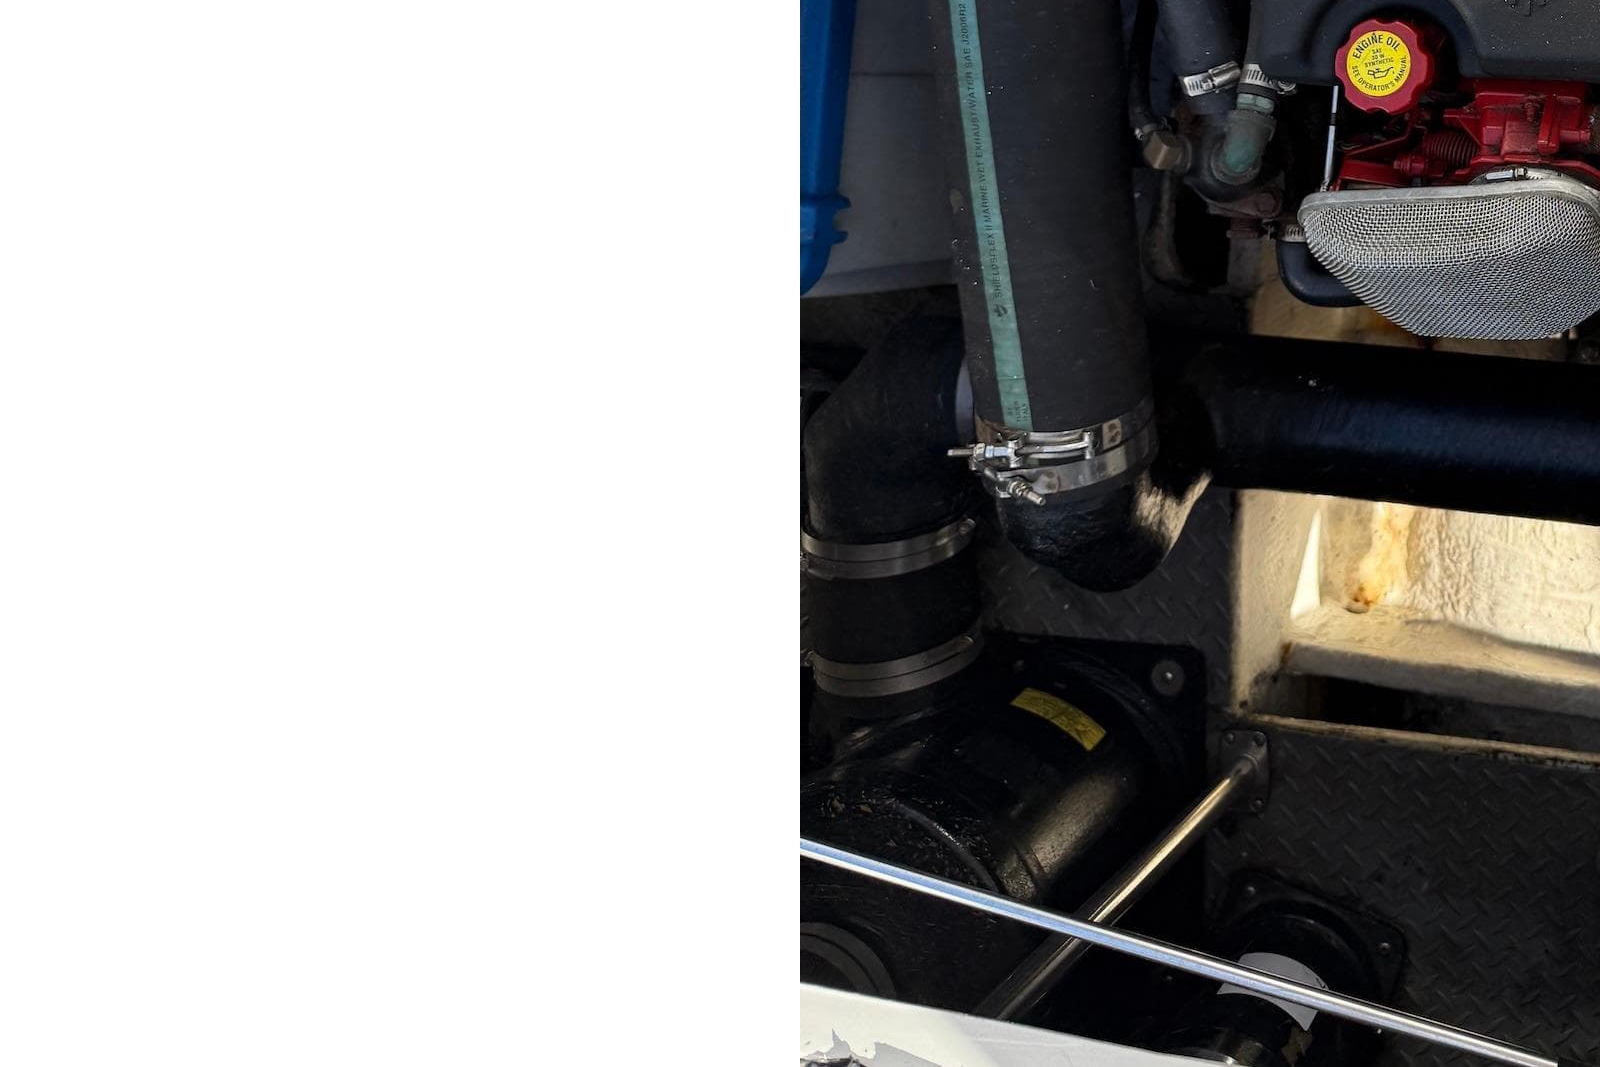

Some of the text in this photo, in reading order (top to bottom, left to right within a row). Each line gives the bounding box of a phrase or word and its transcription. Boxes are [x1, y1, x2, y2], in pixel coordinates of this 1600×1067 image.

[963, 47, 974, 68] SAE
[1353, 34, 1400, 59] ENGINE OIL
[1358, 76, 1395, 91] OPERATOR'S
[1395, 55, 1407, 84] MANUAL
[976, 161, 985, 183] WET
[979, 186, 992, 224] MARINE
